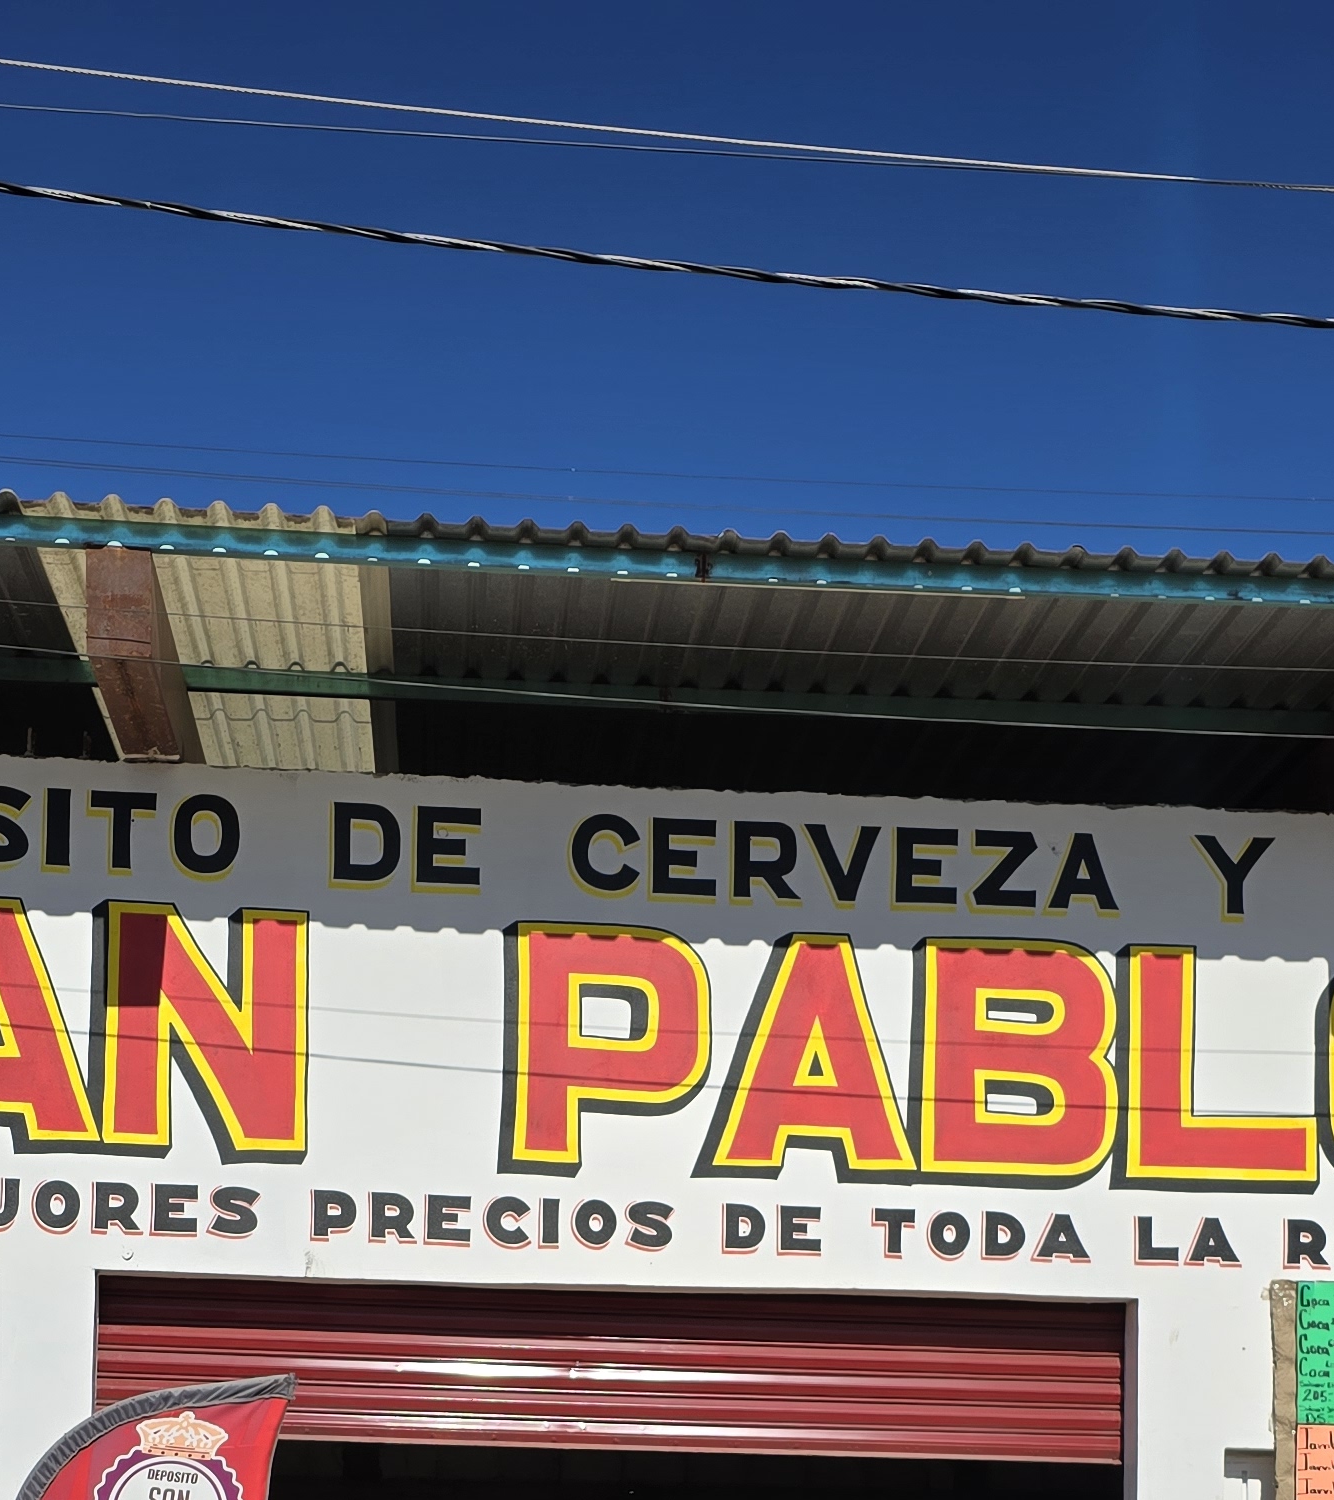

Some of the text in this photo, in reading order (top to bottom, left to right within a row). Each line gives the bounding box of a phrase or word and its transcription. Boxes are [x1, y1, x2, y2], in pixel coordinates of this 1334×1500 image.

[328, 802, 482, 894] DE
[569, 813, 1119, 916] CERVEZA
[1191, 834, 1275, 923] Y
[309, 1189, 675, 1252] PRECIOS
[721, 1203, 822, 1258] DE
[872, 1208, 1091, 1267] TODA
[1133, 1215, 1242, 1269] LA
[147, 1468, 199, 1485] DEPOSITO
